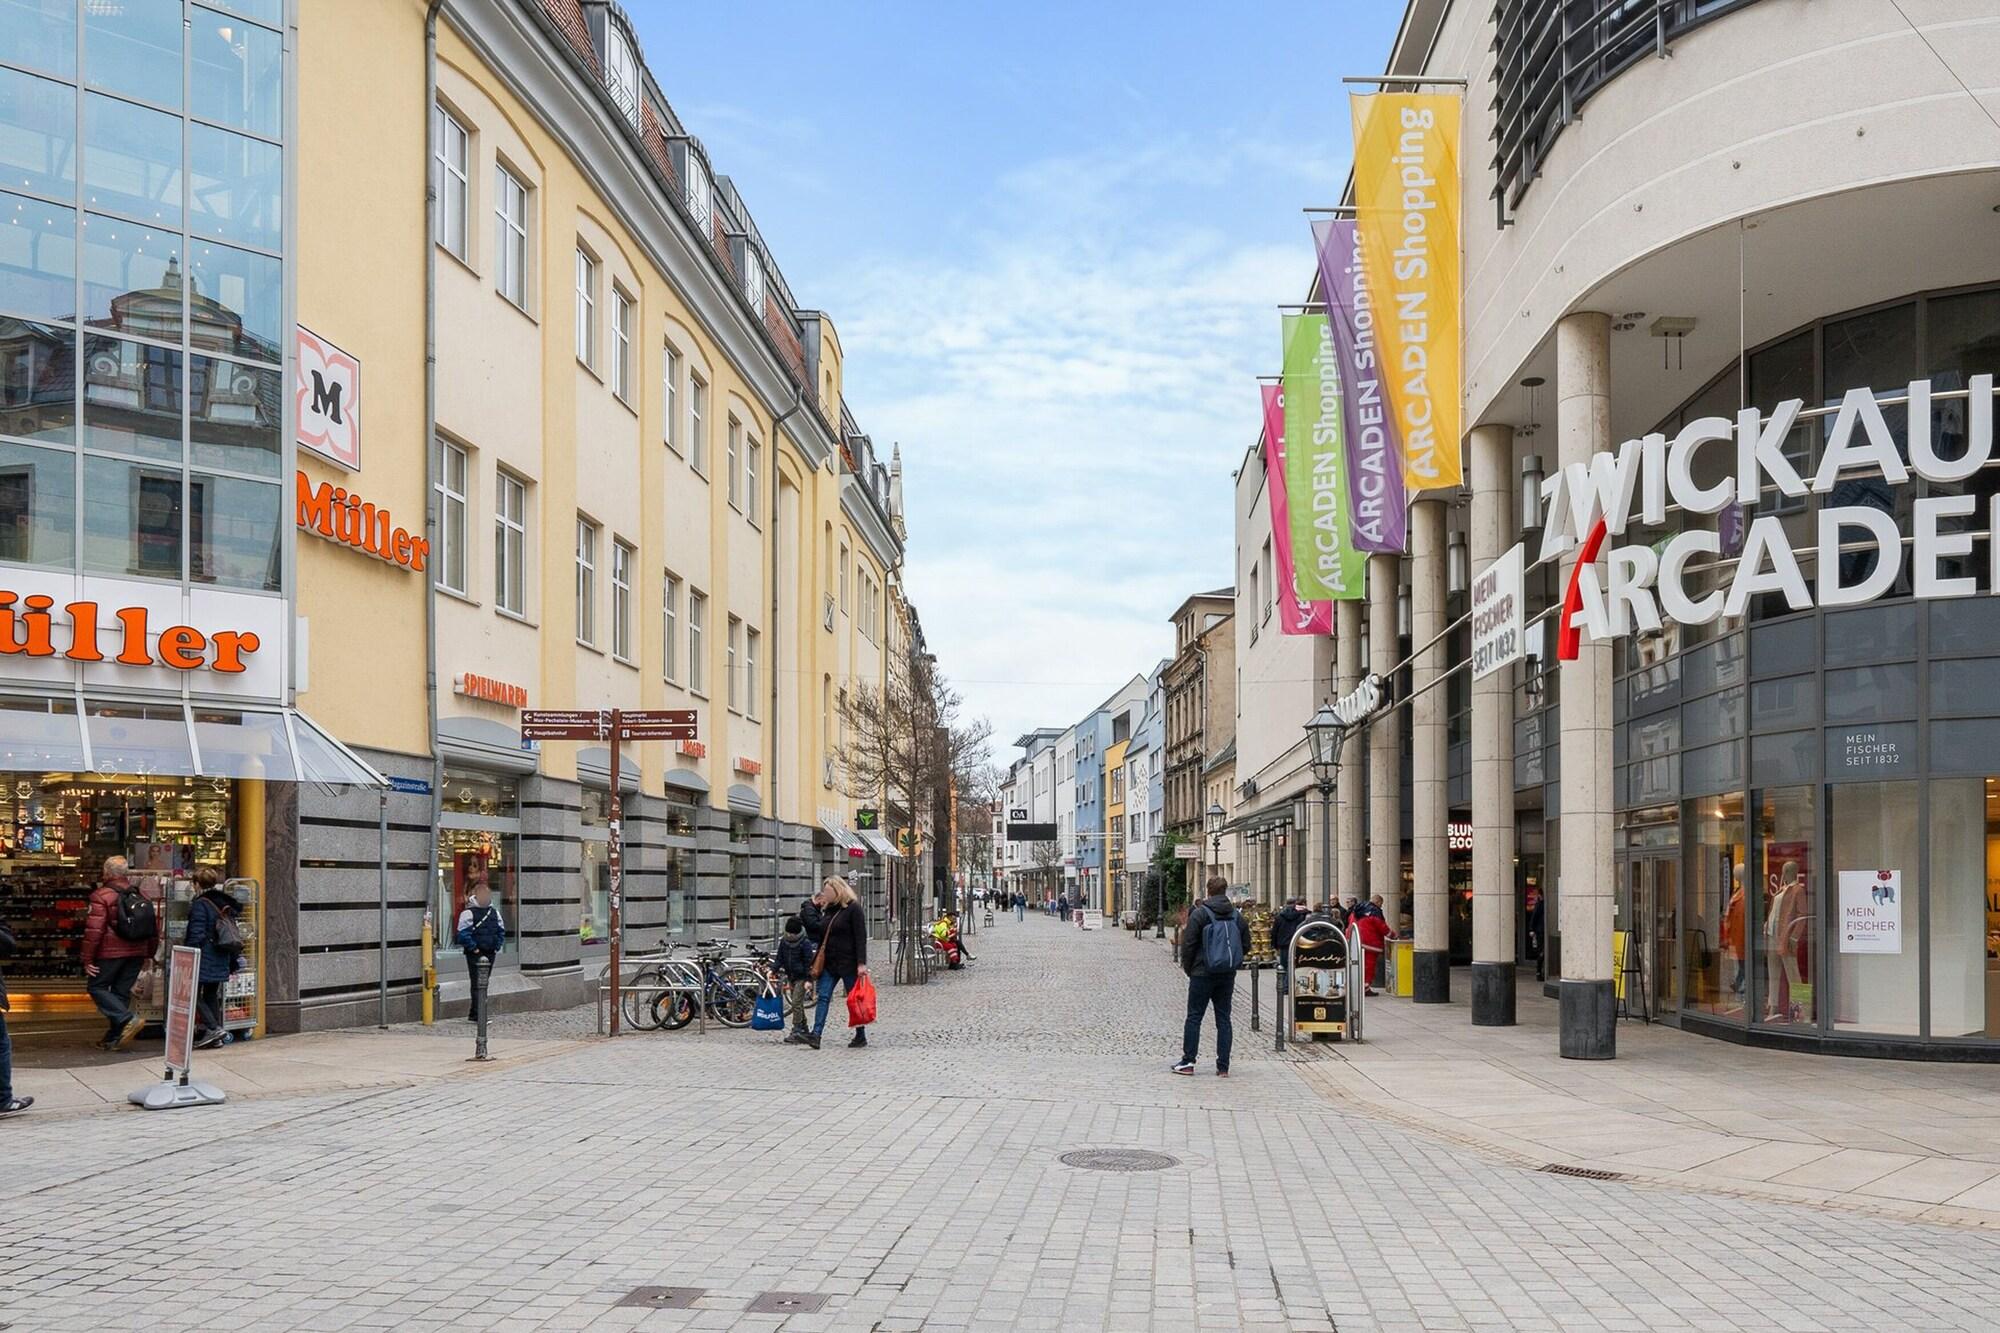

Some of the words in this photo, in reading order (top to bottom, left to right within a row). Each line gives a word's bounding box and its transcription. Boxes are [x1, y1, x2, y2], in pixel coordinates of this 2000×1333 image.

[1392, 107, 1436, 281] Shopping
[311, 369, 343, 425] M
[1396, 291, 1438, 479] ARCADEN
[1356, 379, 1385, 543] ARCADEN
[1539, 374, 1993, 563] ZWICKAU
[297, 469, 430, 573] Müller
[1313, 453, 1347, 592] ARCADEN
[1473, 570, 1497, 607] MEIN
[1557, 492, 2000, 661] ARCADE
[0, 590, 261, 673] üller
[1474, 594, 1514, 640] FISCHER
[1473, 642, 1494, 674] SEIT
[1495, 627, 1517, 662] 1832
[463, 672, 528, 708] SPIELWAREN
[1846, 734, 1876, 744] MEIN
[1846, 743, 1896, 755] FISCHER
[1846, 756, 1872, 766] SEIT
[1875, 754, 1900, 764] 1832
[1769, 873, 1806, 897] SE
[1846, 907, 1876, 917] MEIN
[1846, 920, 1896, 931] FISCHER
